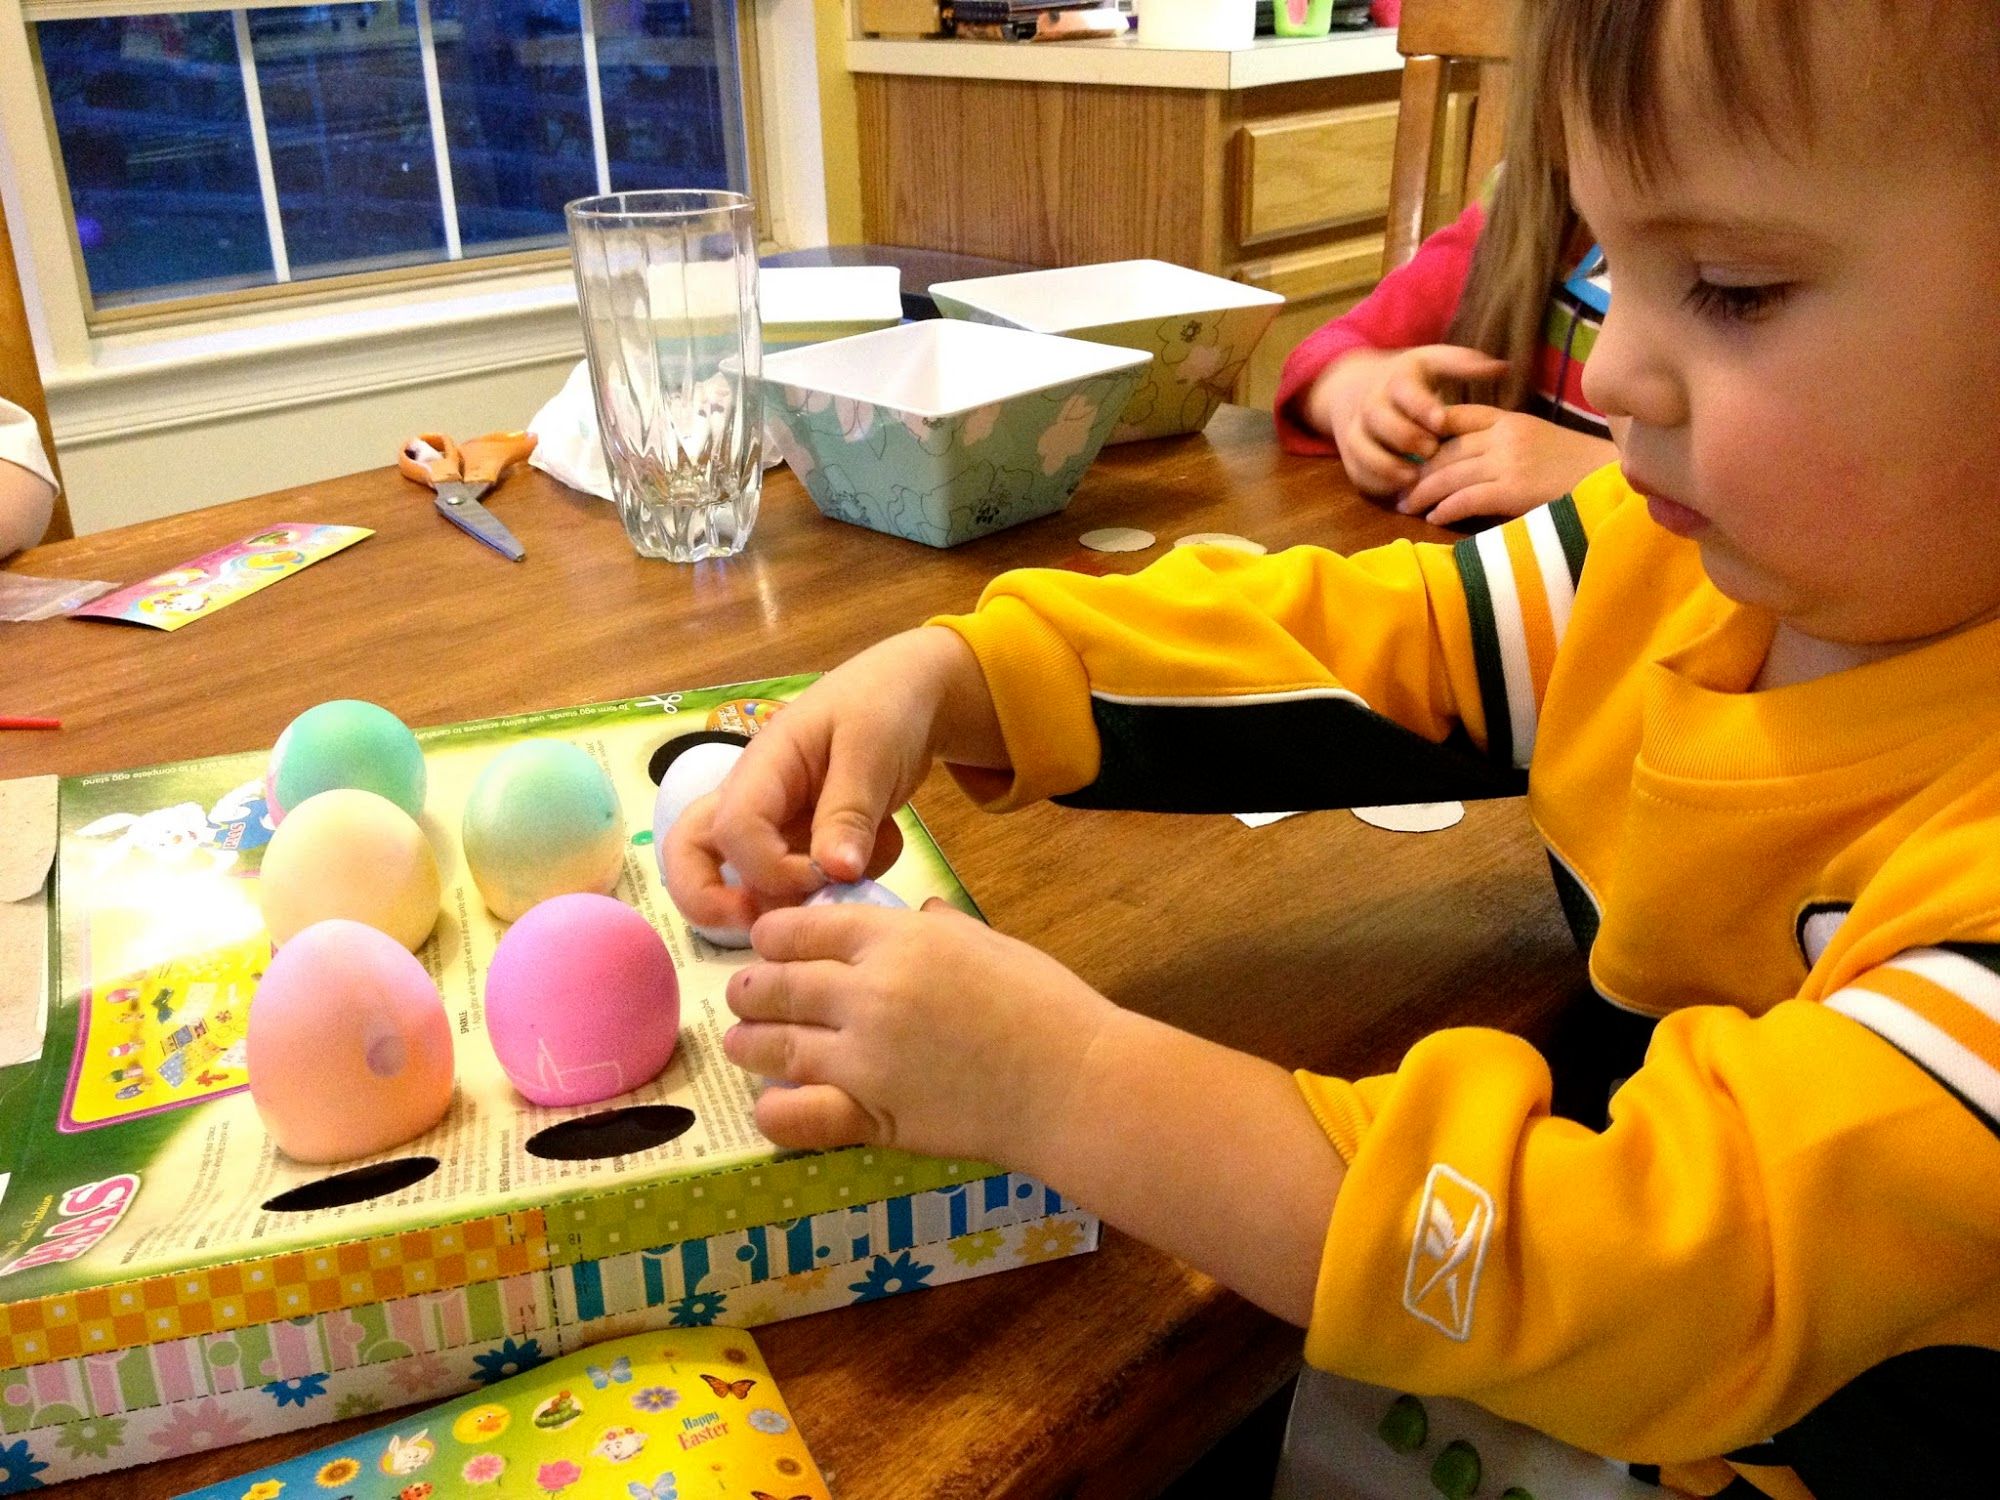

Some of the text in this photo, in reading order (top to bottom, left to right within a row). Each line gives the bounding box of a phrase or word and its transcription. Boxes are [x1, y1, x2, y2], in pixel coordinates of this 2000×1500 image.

[579, 707, 597, 716] egg
[597, 705, 618, 713] form
[618, 703, 631, 711] To
[501, 718, 527, 727] safety
[529, 715, 545, 723] use
[463, 721, 499, 733] scissors
[133, 766, 177, 778] complete
[111, 772, 131, 782] egg
[682, 1411, 720, 1431] Happy
[677, 1422, 728, 1451] Easter
